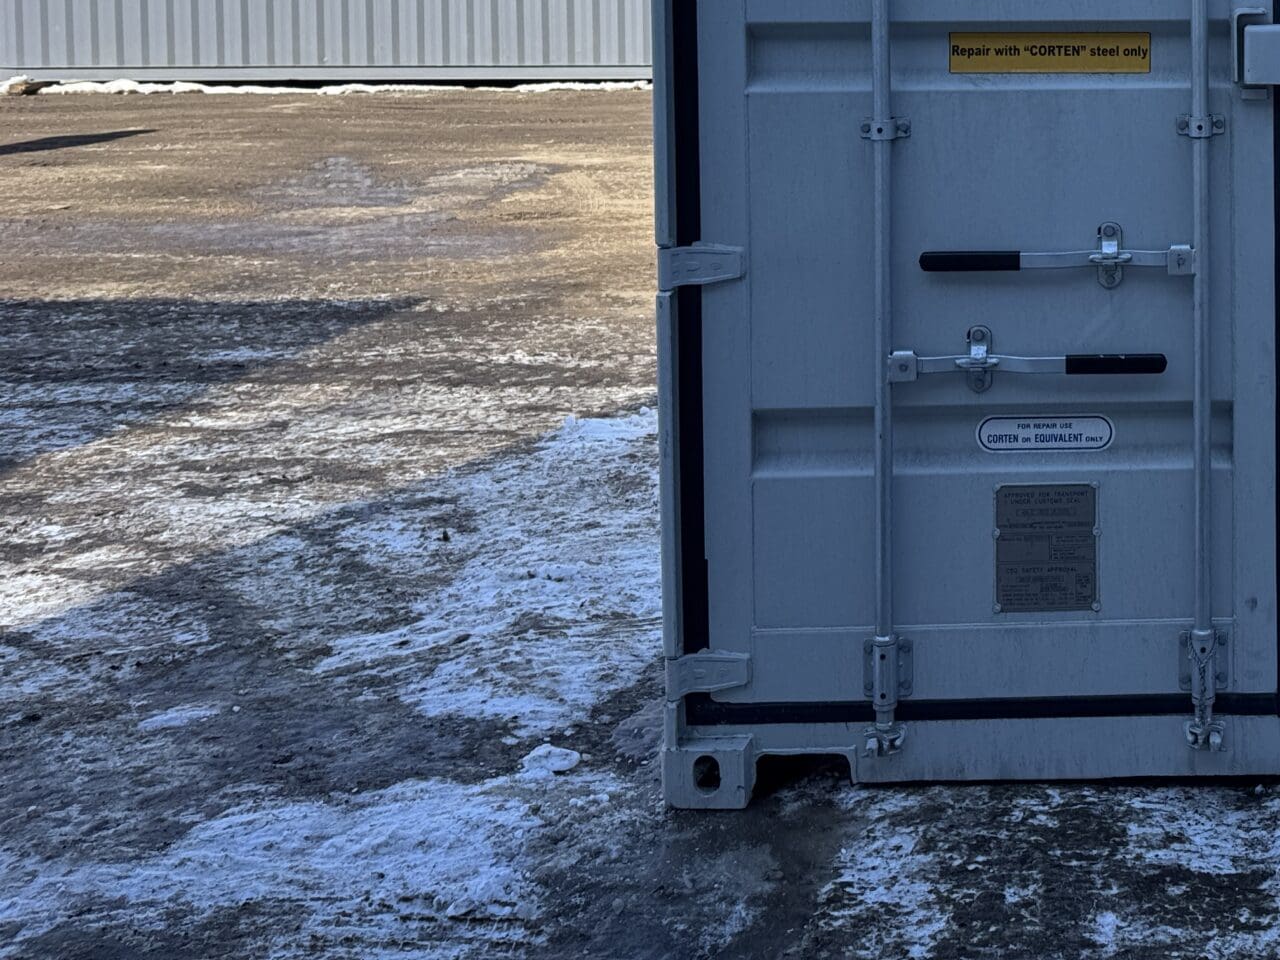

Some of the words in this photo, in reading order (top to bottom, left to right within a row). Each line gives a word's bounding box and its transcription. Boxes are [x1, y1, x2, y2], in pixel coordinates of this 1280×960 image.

[951, 45, 991, 58] Repair
[994, 45, 1020, 57] with
[1090, 45, 1120, 57] steel
[1123, 45, 1148, 59] only
[1033, 422, 1057, 430] REPAIR
[987, 434, 1019, 444] CORTEN
[1035, 433, 1083, 443] EQUIVALENT
